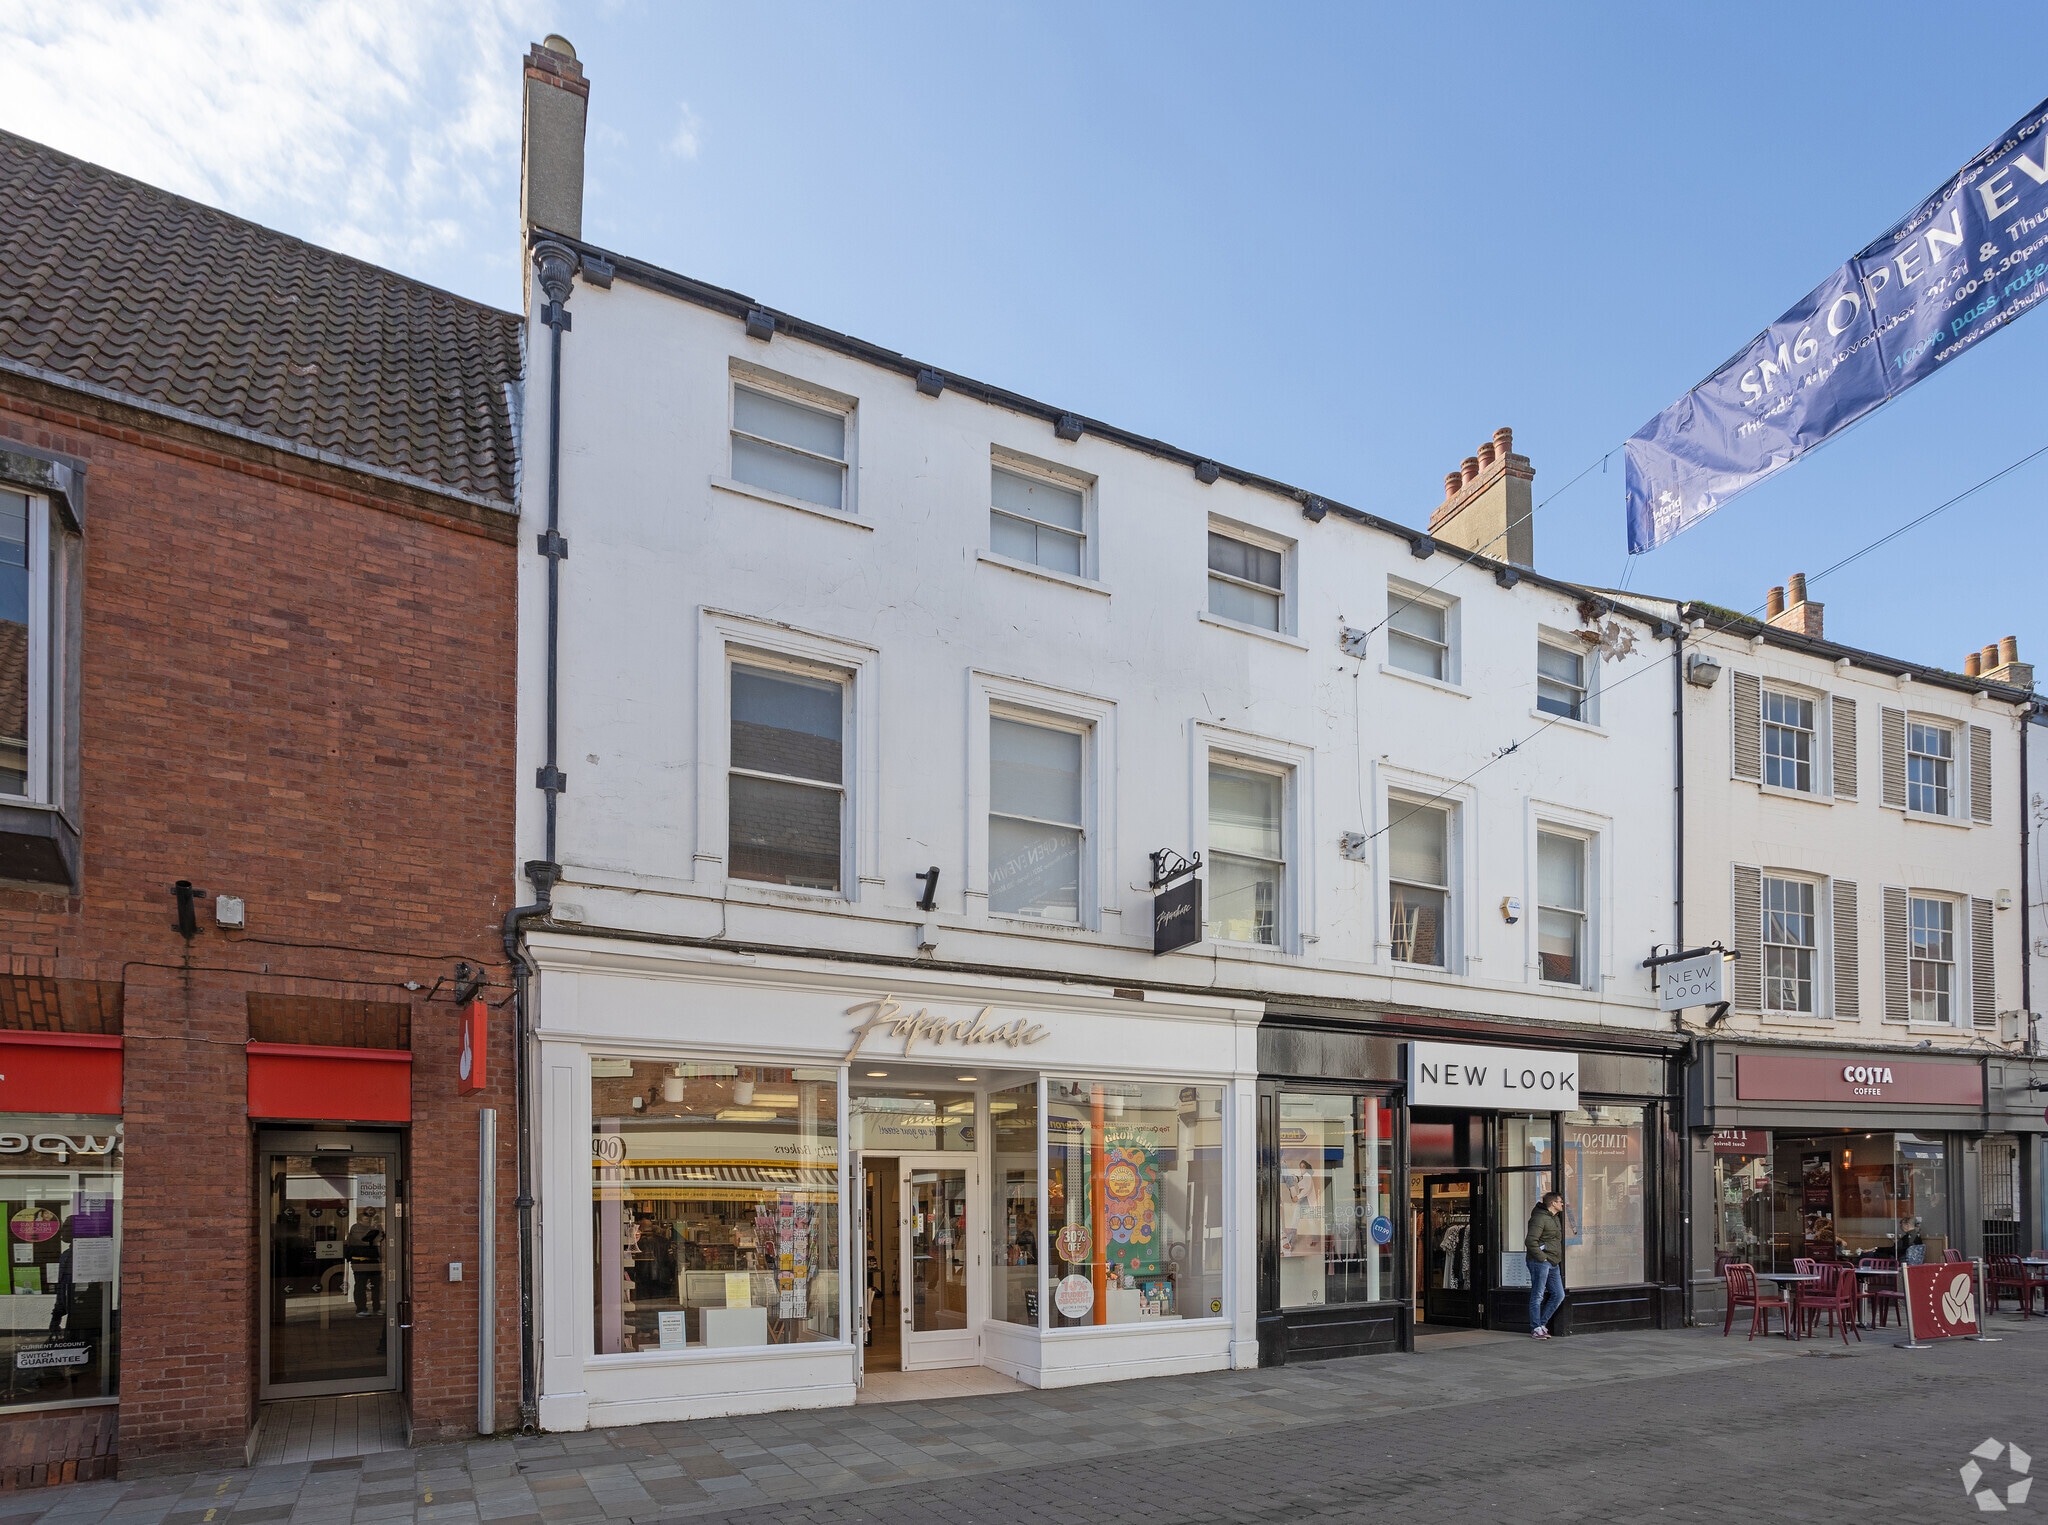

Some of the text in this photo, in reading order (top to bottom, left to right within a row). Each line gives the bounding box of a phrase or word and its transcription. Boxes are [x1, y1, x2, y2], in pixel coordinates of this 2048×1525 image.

[1984, 138, 2018, 167] Sixth
[1979, 241, 2000, 263] &
[1739, 325, 1819, 408] SM6
[1826, 207, 1965, 337] OPEN
[1894, 327, 1946, 369] 100%
[1950, 294, 1998, 337] pass
[1668, 966, 1712, 985] NEW
[1664, 980, 1716, 1001] LOOK
[844, 993, 1051, 1063] Paperchase
[1420, 1062, 1575, 1092] NEW LOOK
[1843, 1065, 1894, 1086] COSTA
[1853, 1087, 1882, 1096] COFFEE
[1063, 1230, 1086, 1243] 30%
[1067, 1242, 1082, 1252] OFF
[20, 1341, 86, 1351] CURRENT ACCOUNT
[20, 1355, 81, 1366] GUARANTEE
